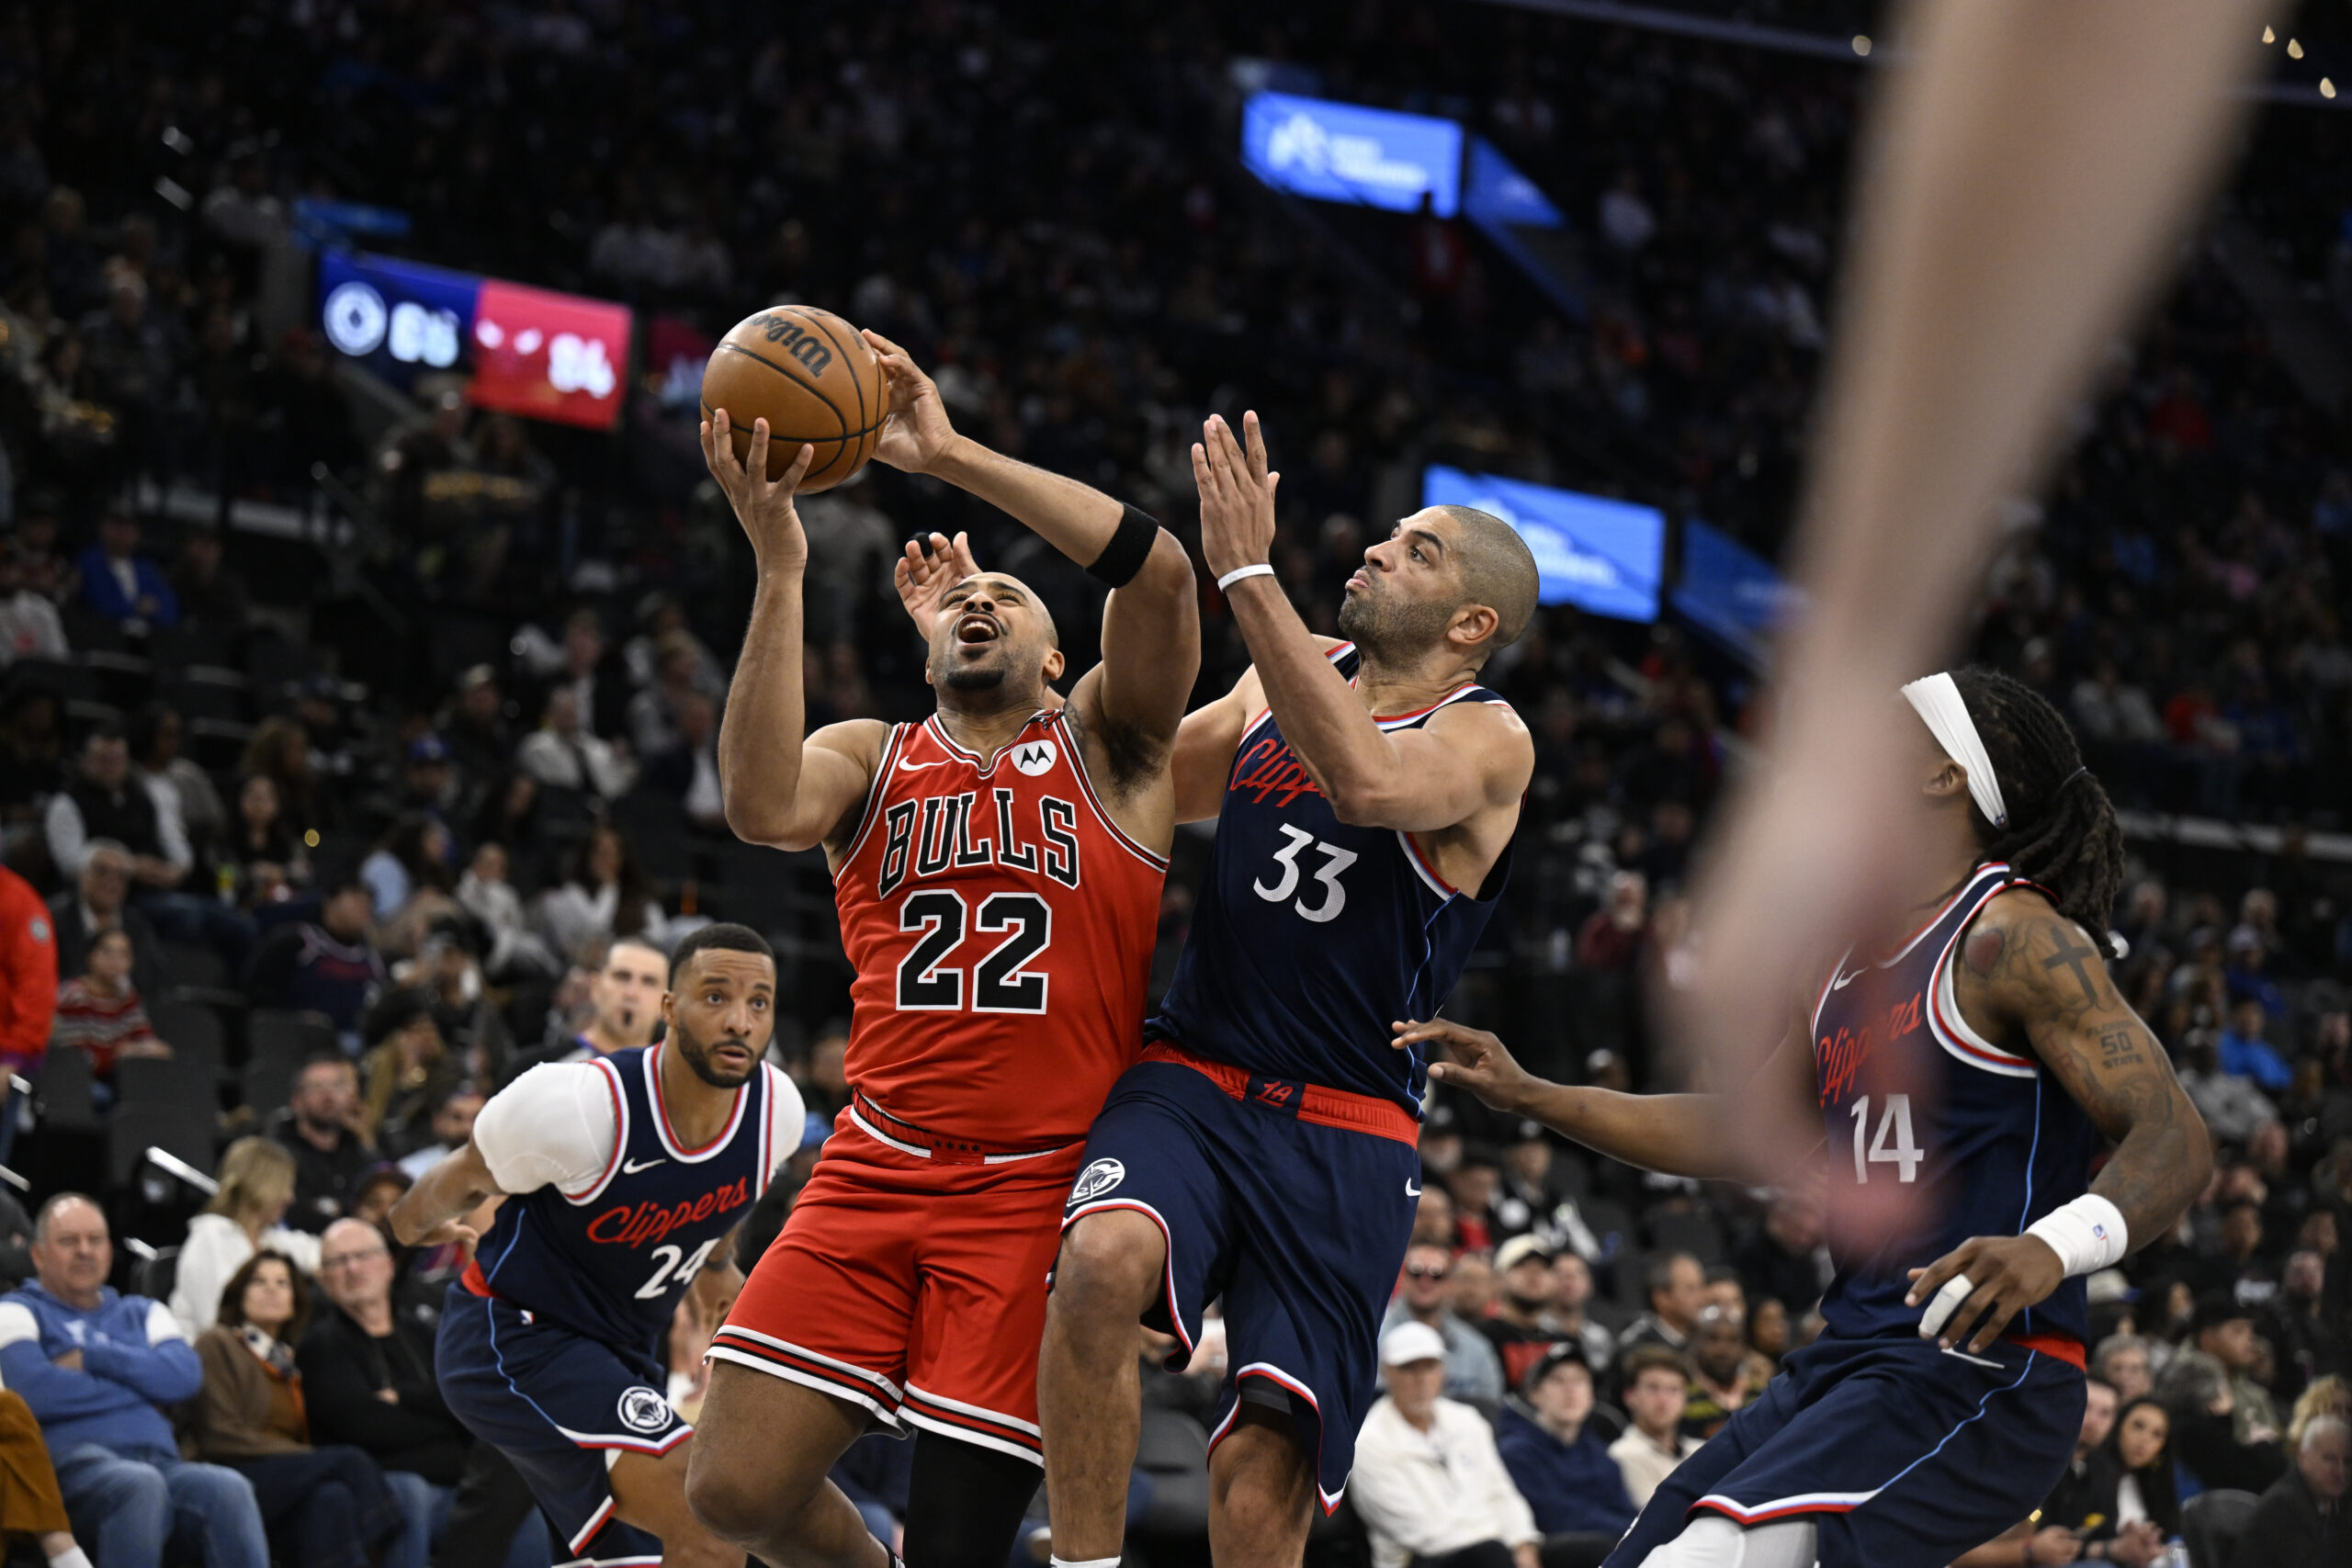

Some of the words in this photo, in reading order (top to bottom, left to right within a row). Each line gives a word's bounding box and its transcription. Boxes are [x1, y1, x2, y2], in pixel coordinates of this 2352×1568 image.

[749, 312, 832, 378] Wilso
[878, 787, 1080, 900] BULLS
[1253, 822, 1358, 922] 33
[896, 888, 1052, 1015] 22
[1817, 991, 1923, 1109] Clipprs
[2100, 1031, 2133, 1055] 50
[1255, 1080, 1294, 1108] LA
[1850, 1093, 1925, 1184] 14
[586, 1176, 749, 1249] Clippers
[634, 1237, 721, 1300] 24
